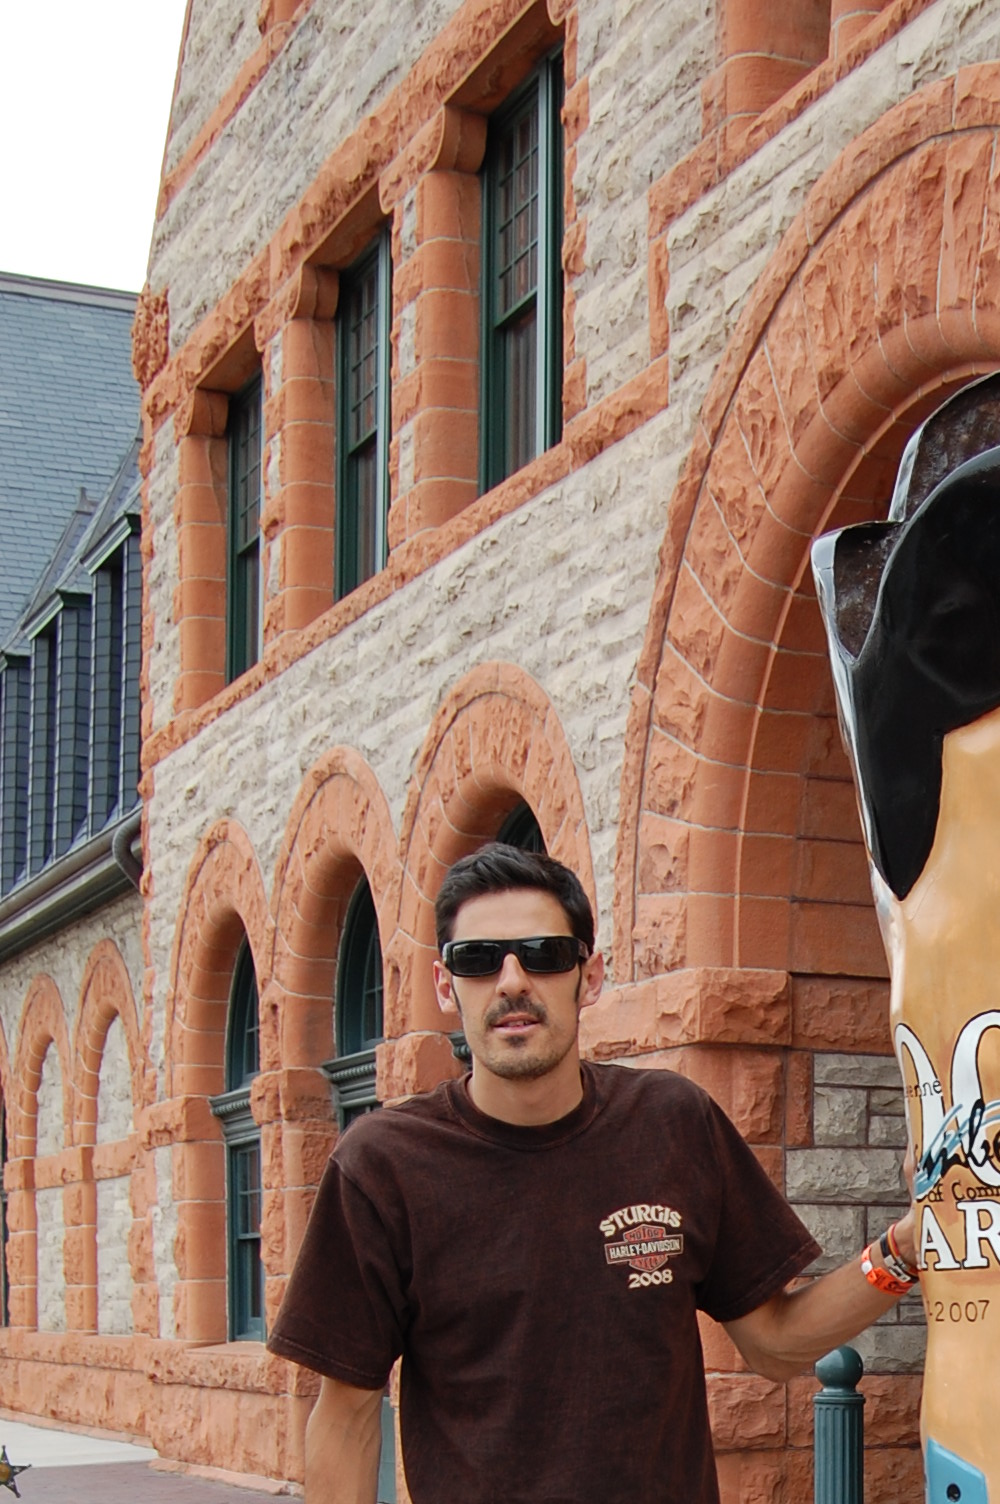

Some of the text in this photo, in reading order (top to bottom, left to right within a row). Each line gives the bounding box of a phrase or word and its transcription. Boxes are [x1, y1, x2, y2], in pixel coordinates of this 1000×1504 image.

[927, 1183, 944, 1203] of
[599, 1204, 682, 1238] STURGIS
[609, 1239, 681, 1260] HARLEY-DAVIDSON
[628, 1269, 674, 1290] 2008
